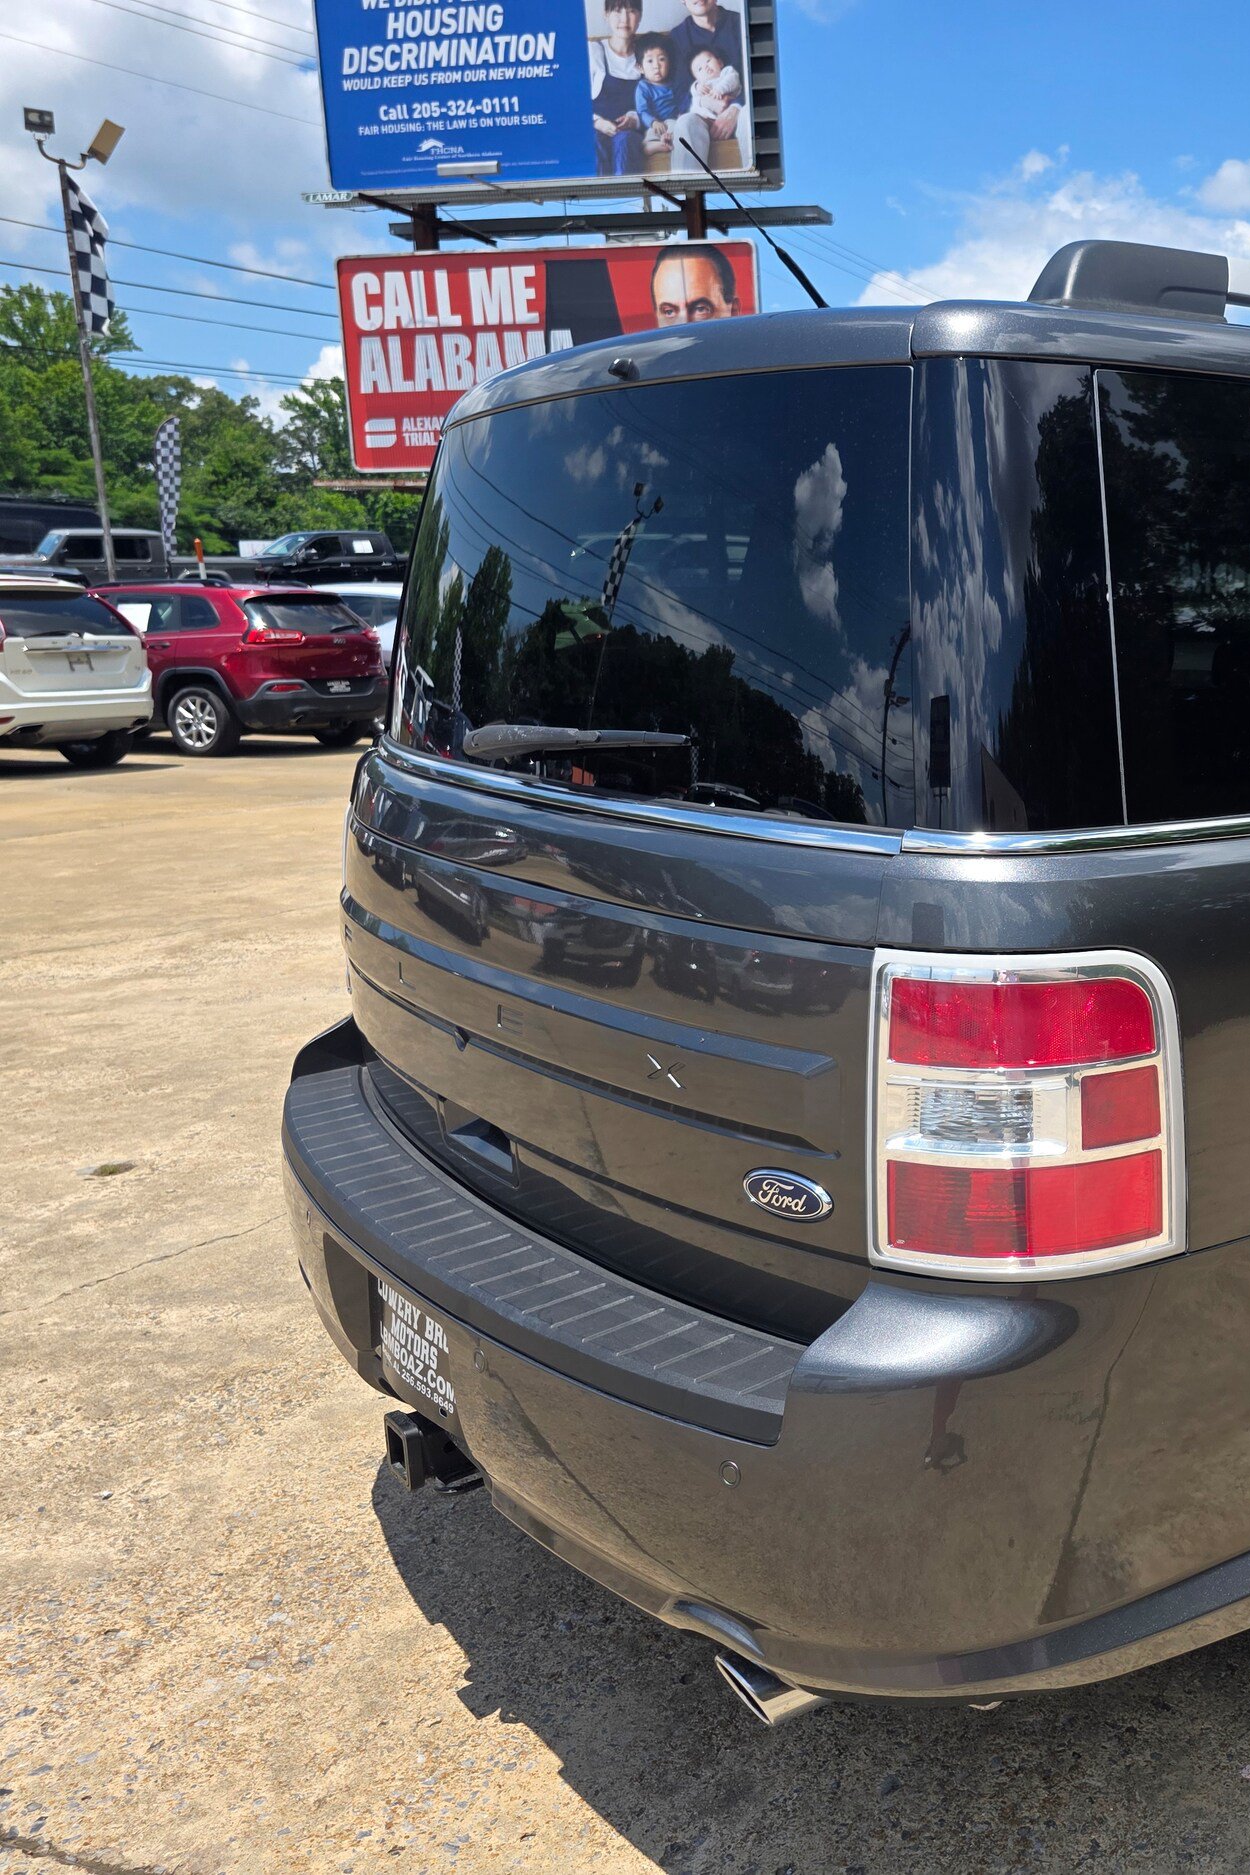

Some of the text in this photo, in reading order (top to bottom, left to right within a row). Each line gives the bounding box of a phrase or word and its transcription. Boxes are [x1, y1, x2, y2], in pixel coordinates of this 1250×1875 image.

[386, 4, 504, 40] HOUSING
[342, 32, 556, 75] DISCRIMINATION
[342, 78, 381, 91] WOULD
[383, 75, 411, 88] KEEP
[414, 73, 429, 86] US
[430, 70, 462, 85] FROM
[463, 68, 487, 82] OUR
[488, 67, 516, 80] NEW
[358, 114, 547, 136] FAIR HOUSING: THE LAW IS ON YOUR SIDE.
[379, 96, 519, 121] Call 205-324-0111
[309, 192, 348, 202] LAMAR
[350, 264, 540, 332] CALL ME
[402, 431, 439, 447] TRIAL
[758, 1179, 807, 1213] Ford
[391, 1313, 438, 1370] MOTORS
[401, 1368, 454, 1414] 256.593.8649
